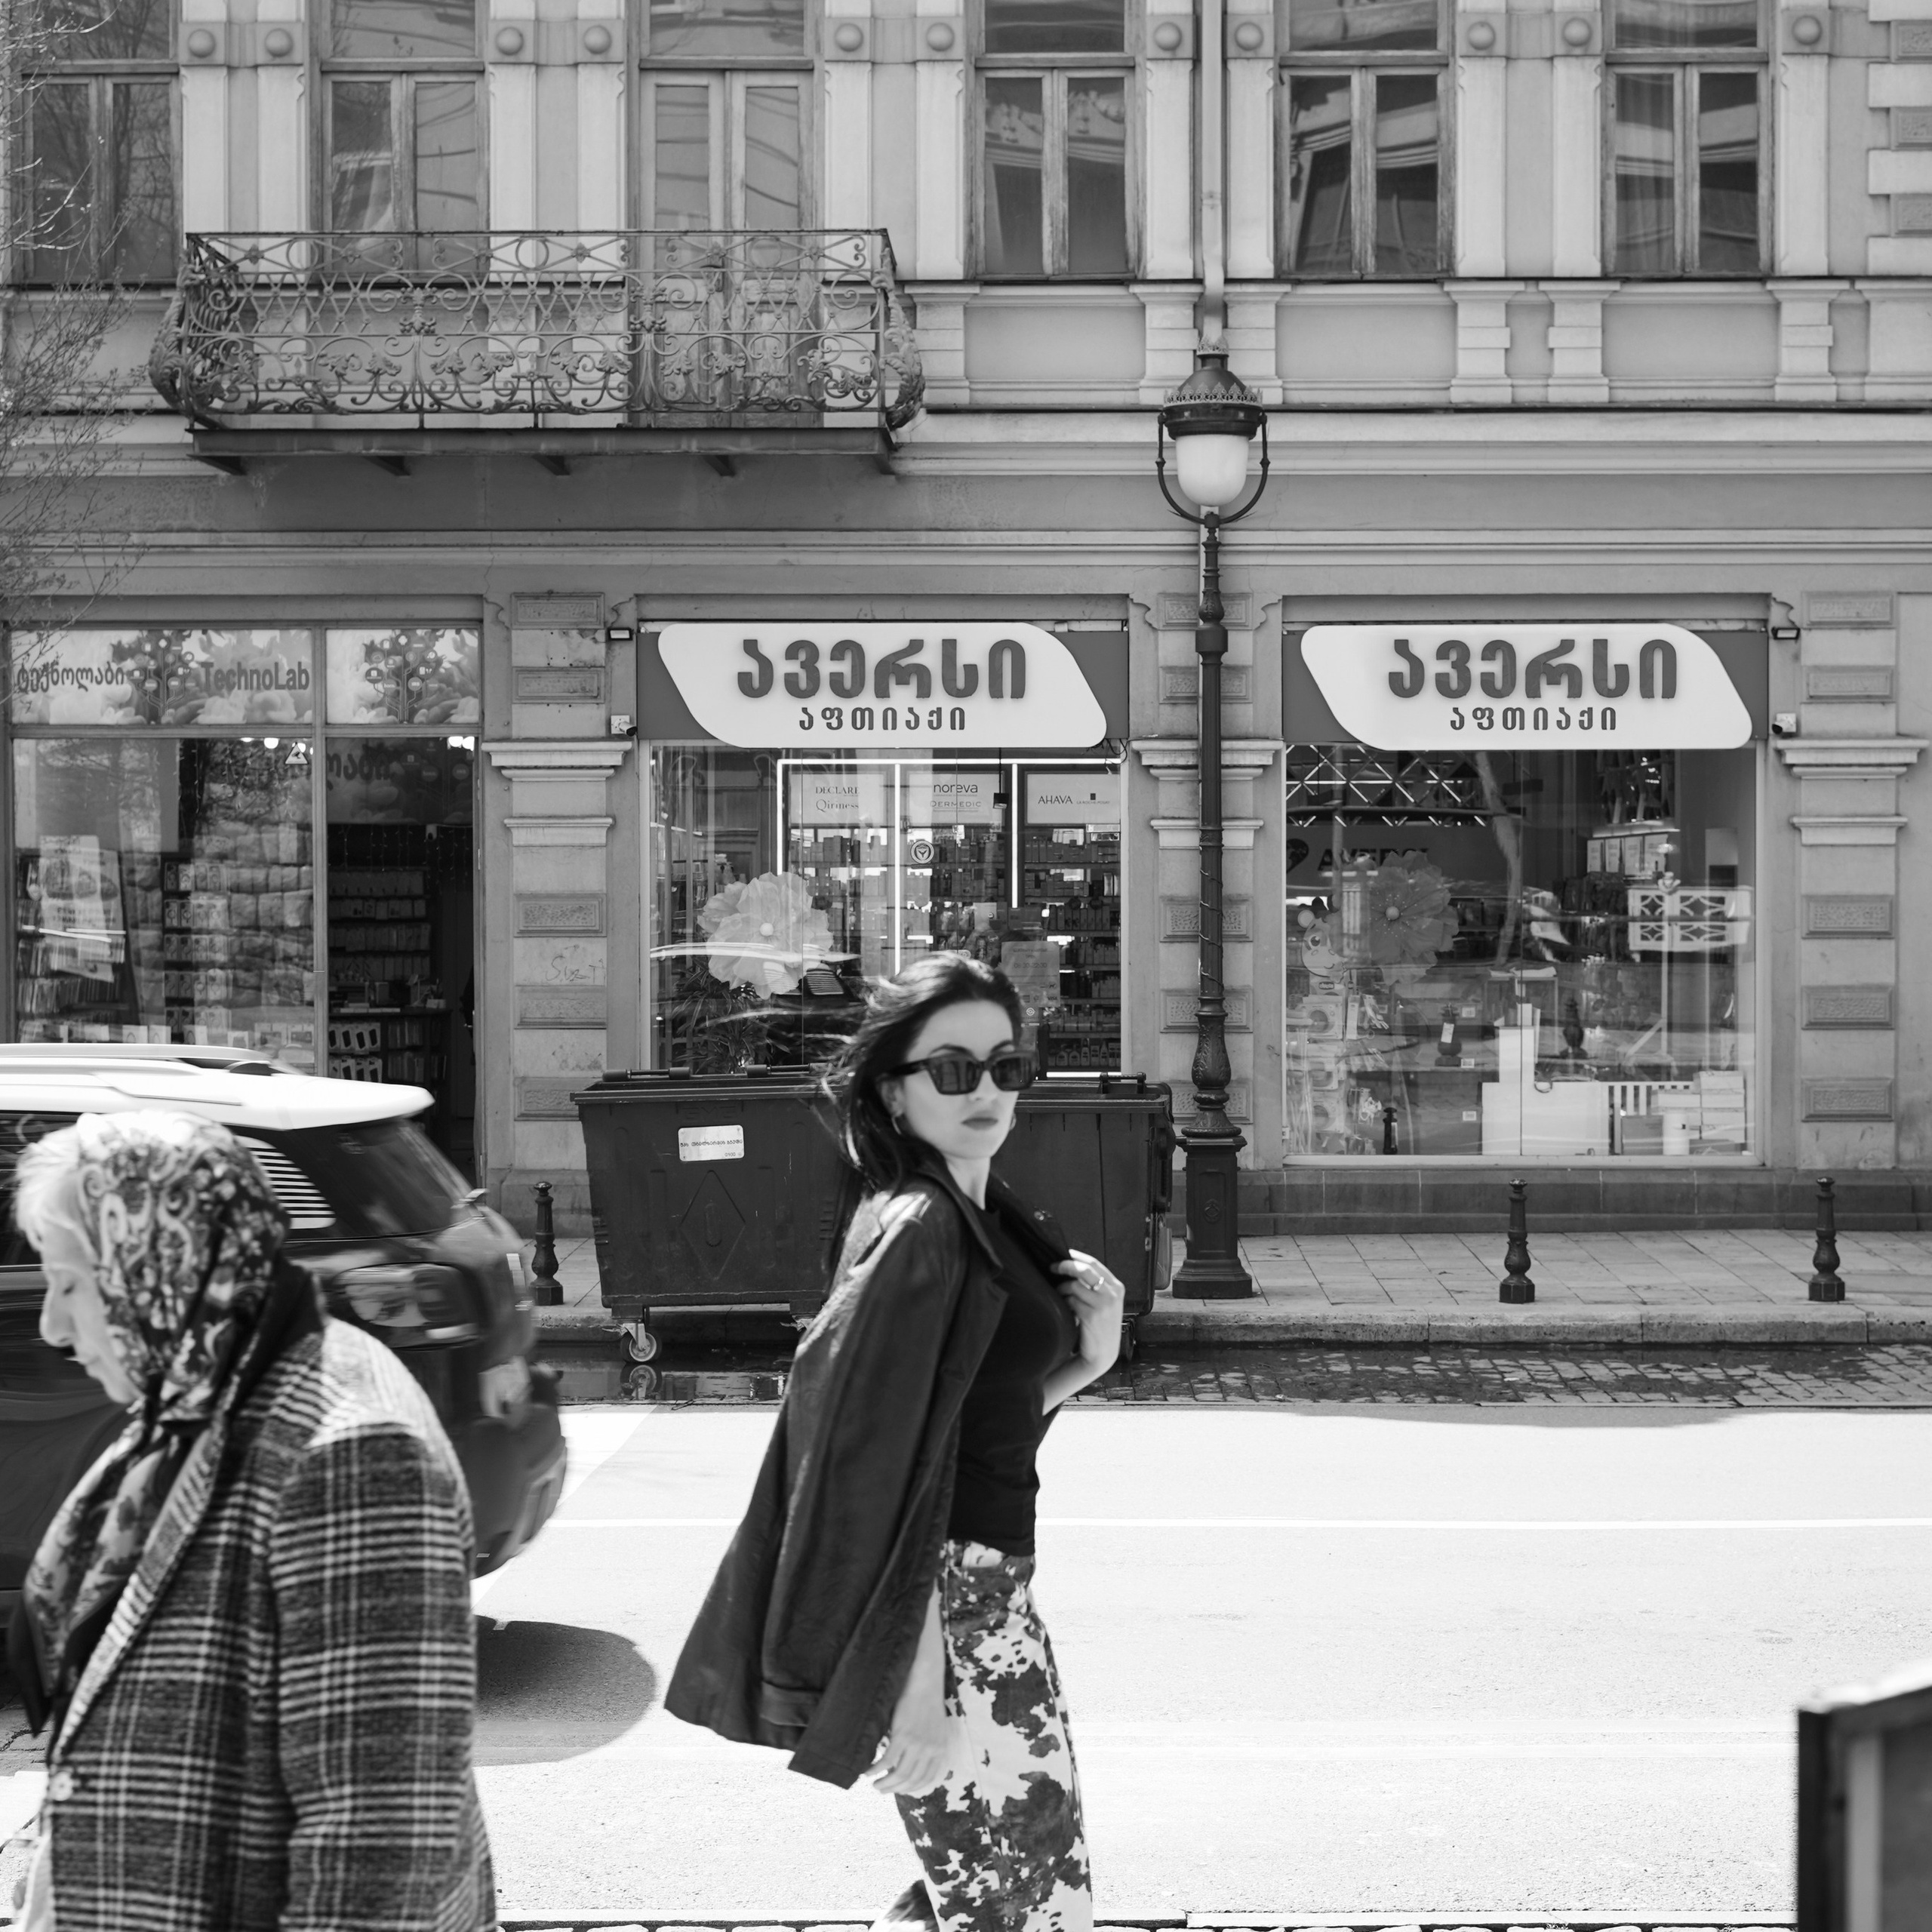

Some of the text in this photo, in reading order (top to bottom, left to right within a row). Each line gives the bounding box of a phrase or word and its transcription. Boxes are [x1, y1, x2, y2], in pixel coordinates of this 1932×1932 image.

[201, 662, 309, 690] TechnoLab
[737, 639, 1026, 699] ავერსი
[1389, 639, 1677, 699] ავერსი
[799, 706, 965, 731] აფთიაქი
[1451, 706, 1617, 731] აფთიაქი
[934, 784, 978, 793] noreva
[1038, 795, 1072, 804] AHAVA
[816, 799, 859, 813] Qiriness
